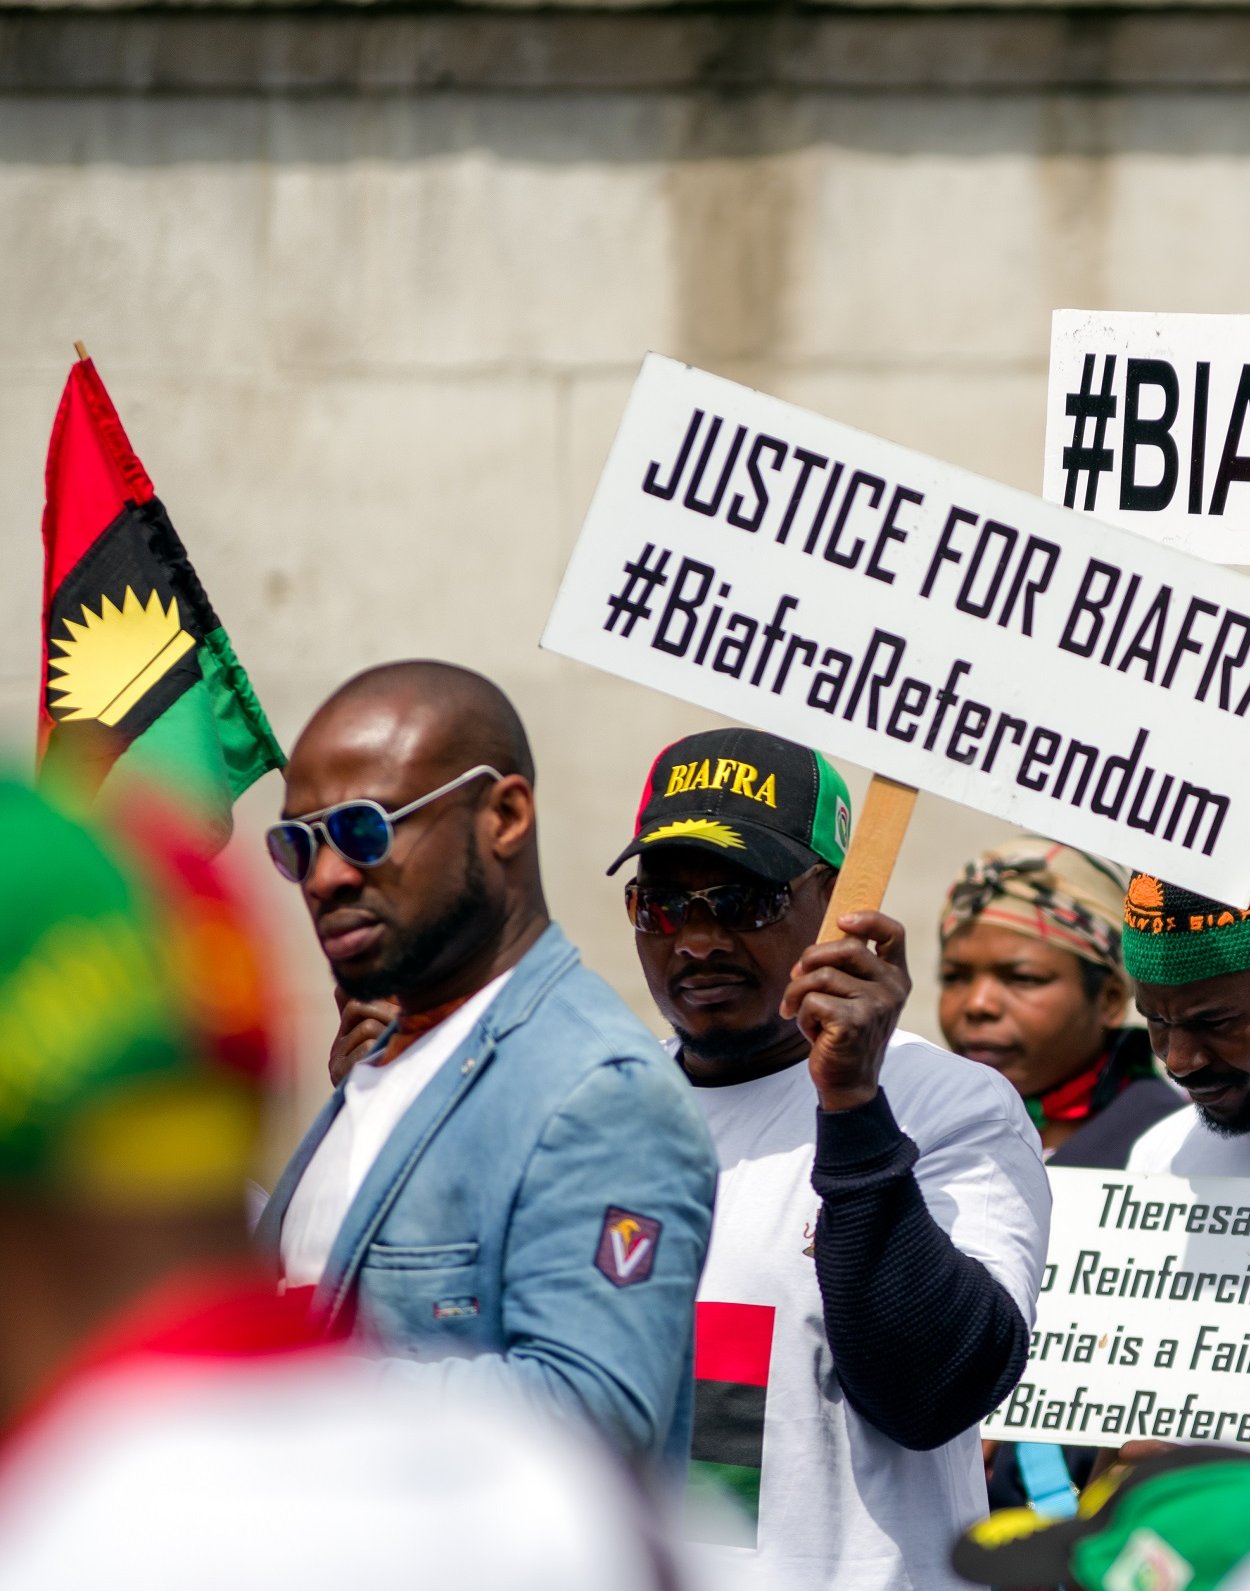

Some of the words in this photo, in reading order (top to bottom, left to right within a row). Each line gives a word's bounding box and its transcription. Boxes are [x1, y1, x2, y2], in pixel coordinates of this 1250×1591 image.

[642, 408, 925, 585] JUSTICE
[920, 507, 1062, 637] FOR
[602, 542, 1232, 857] #BiafraReferendum
[664, 758, 777, 808] BIAFRA
[1107, 1325, 1144, 1366] is
[1153, 1339, 1179, 1369] a
